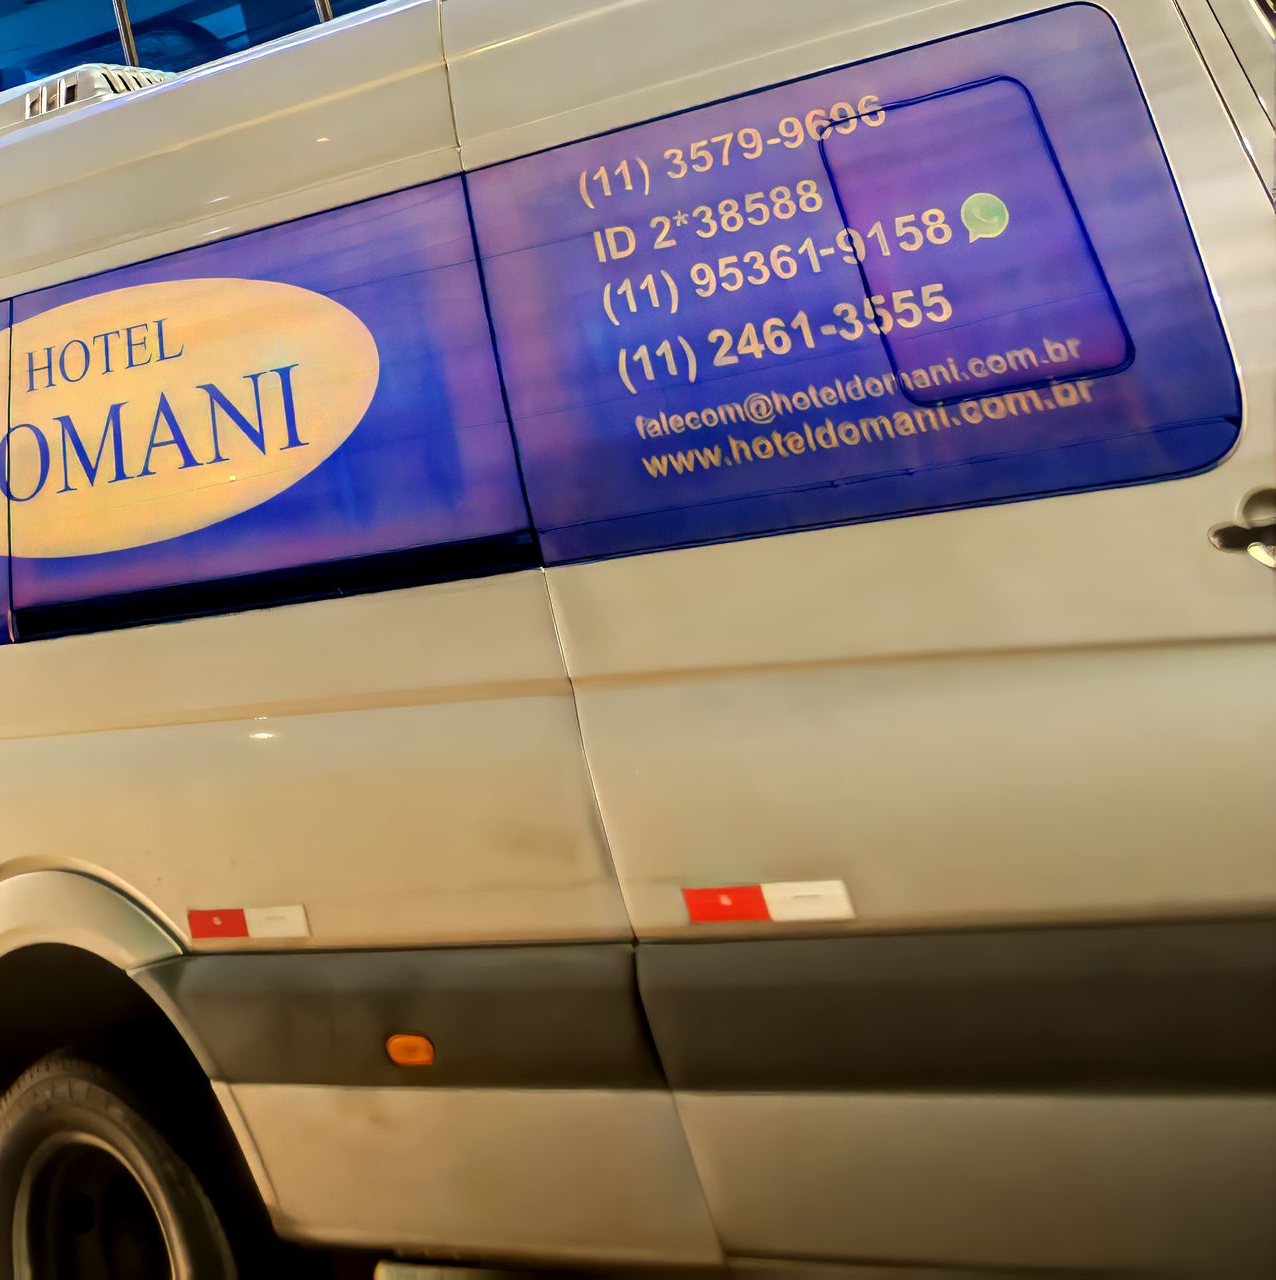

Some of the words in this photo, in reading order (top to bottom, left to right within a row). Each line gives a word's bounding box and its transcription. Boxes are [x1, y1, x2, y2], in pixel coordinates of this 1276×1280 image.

[579, 157, 650, 209] (11)
[664, 95, 886, 179] 3579-9696
[593, 225, 636, 263] ID
[603, 269, 679, 326] (11)
[689, 208, 953, 298] 95361-9158
[26, 318, 185, 393] HOTEL
[618, 336, 697, 395] (11)
[707, 283, 953, 367] 2461-3555
[642, 377, 1093, 478] www.hoteldomani.com.br
